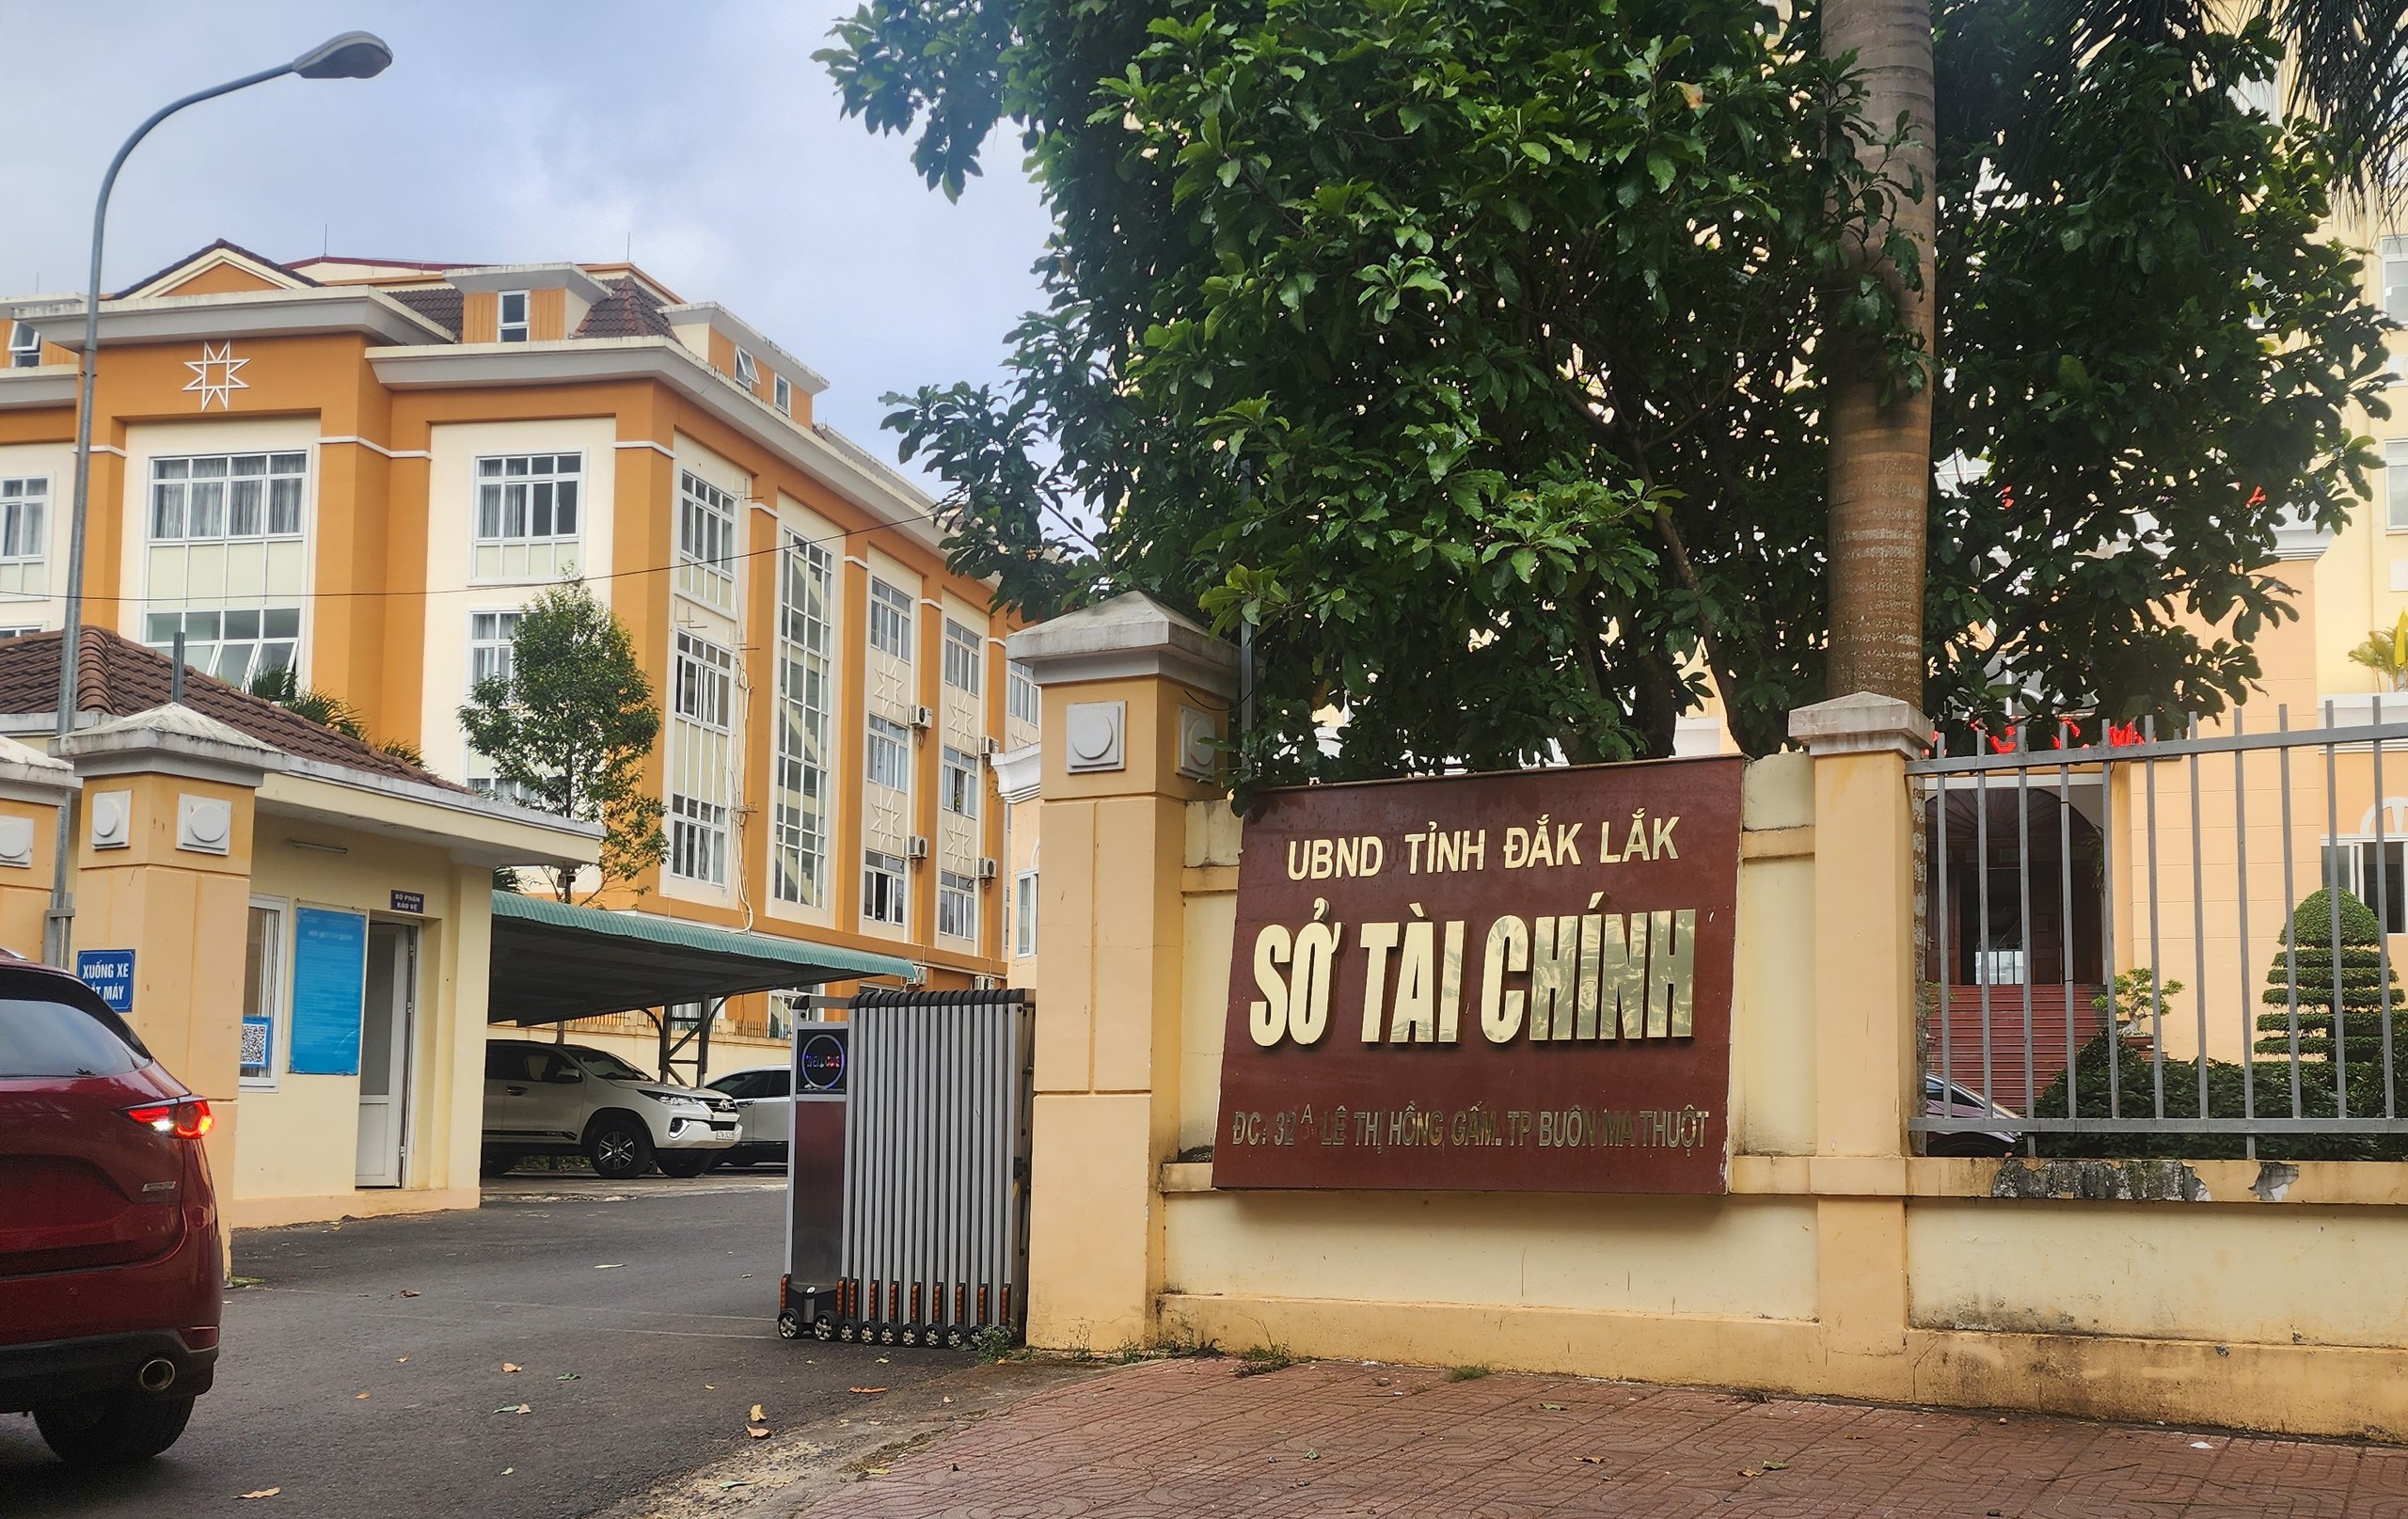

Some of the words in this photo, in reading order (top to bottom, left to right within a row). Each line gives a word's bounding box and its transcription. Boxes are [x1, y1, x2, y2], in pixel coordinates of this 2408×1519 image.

[1287, 834, 1384, 881] UBND
[1404, 820, 1486, 874] TỈNH
[1502, 814, 1584, 870] ĐẮK
[1598, 807, 1681, 865] LẮK
[82, 959, 115, 979] XUỐNG
[116, 962, 129, 977] XE
[103, 983, 124, 1000] MÁY
[1249, 896, 1346, 1048] SỞ
[1359, 902, 1466, 1045] TÀI
[1480, 891, 1697, 1045] CHÍNH
[1321, 1104, 1349, 1147] LÊ
[1354, 1111, 1385, 1155] THỊ
[1387, 1100, 1445, 1147] HỒNG
[1507, 1110, 1533, 1147] TP
[1538, 1104, 1597, 1148] BUÔN
[1602, 1109, 1635, 1148] MA
[1639, 1103, 1711, 1158] THUỘT
